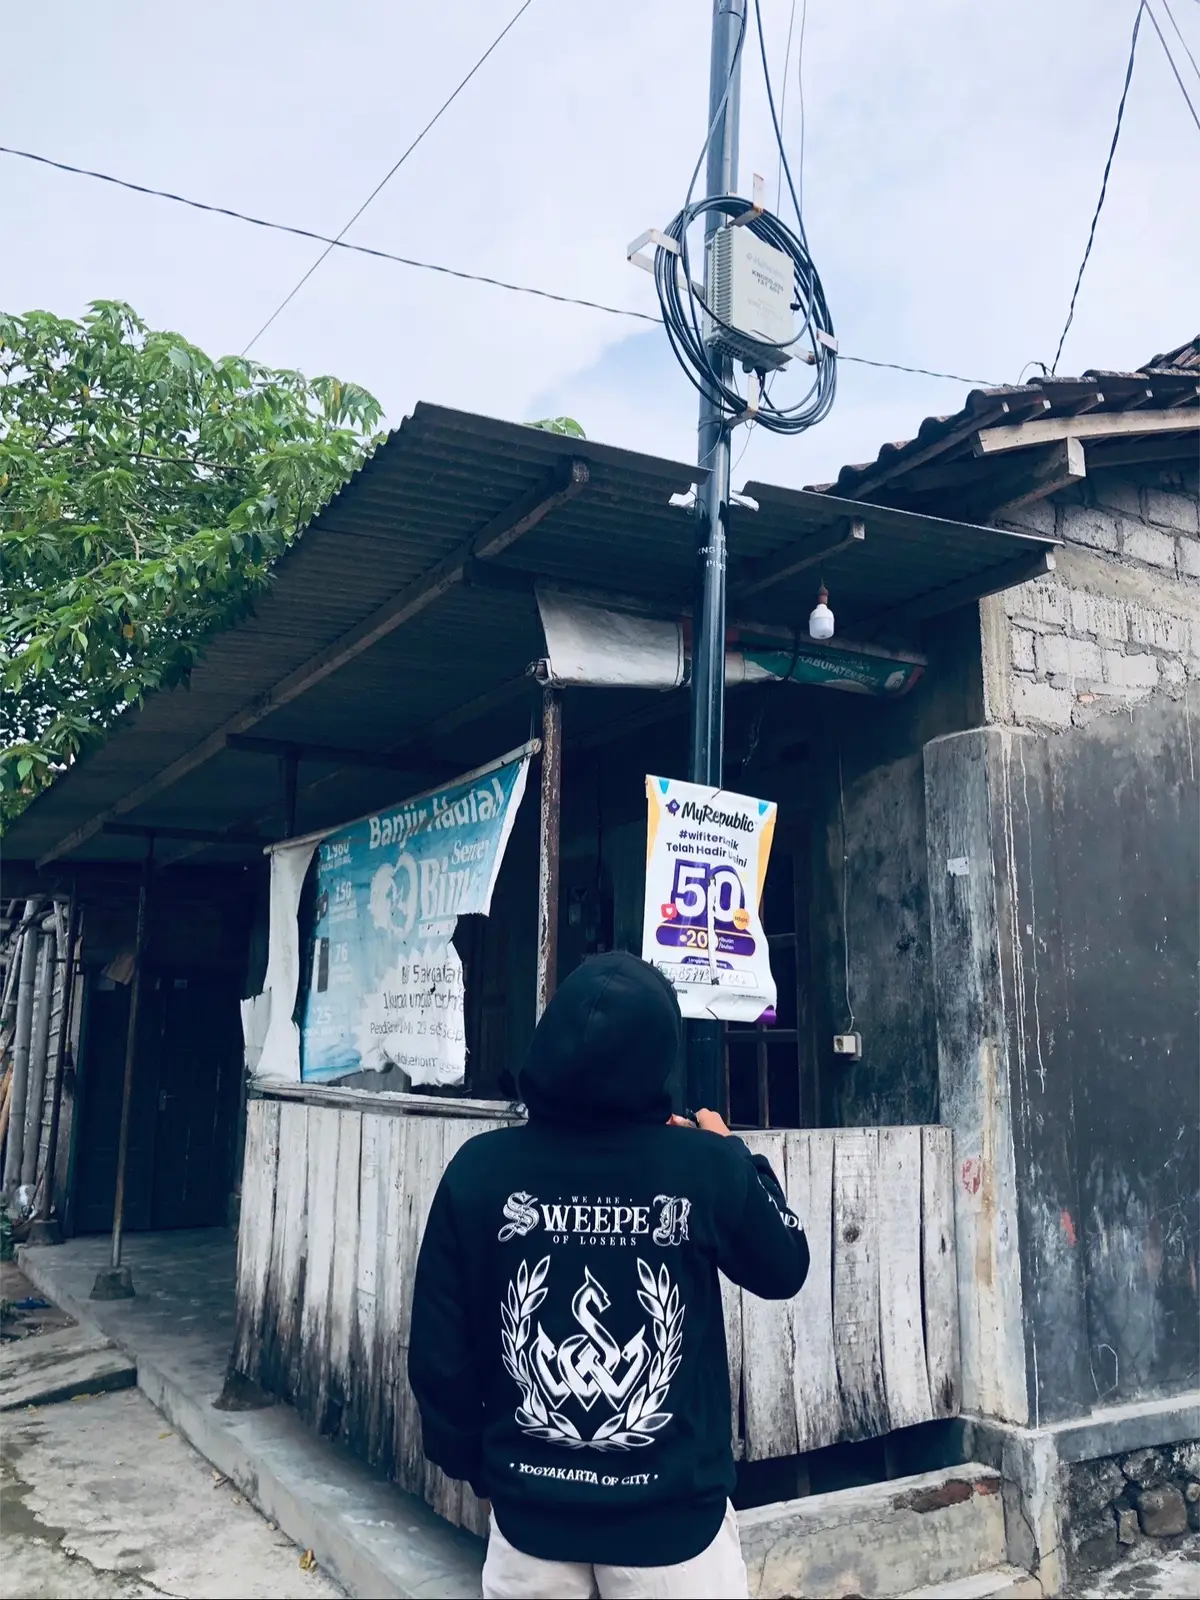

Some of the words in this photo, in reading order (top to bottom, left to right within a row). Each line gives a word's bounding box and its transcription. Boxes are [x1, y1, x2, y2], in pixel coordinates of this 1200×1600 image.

[369, 804, 428, 850] Banjir
[681, 801, 755, 833] MyRepublic
[666, 842, 694, 855] Telah
[696, 845, 727, 858] Hadir
[674, 864, 744, 922] 50
[571, 1195, 588, 1204] WE
[596, 1195, 621, 1205] ARE
[497, 1190, 692, 1247] SWEEPER
[552, 1234, 570, 1245] OF
[580, 1235, 637, 1247] LOSERS
[519, 1462, 599, 1485] YOGYAKARTA
[600, 1474, 619, 1487] OF
[621, 1472, 651, 1486] CITY
